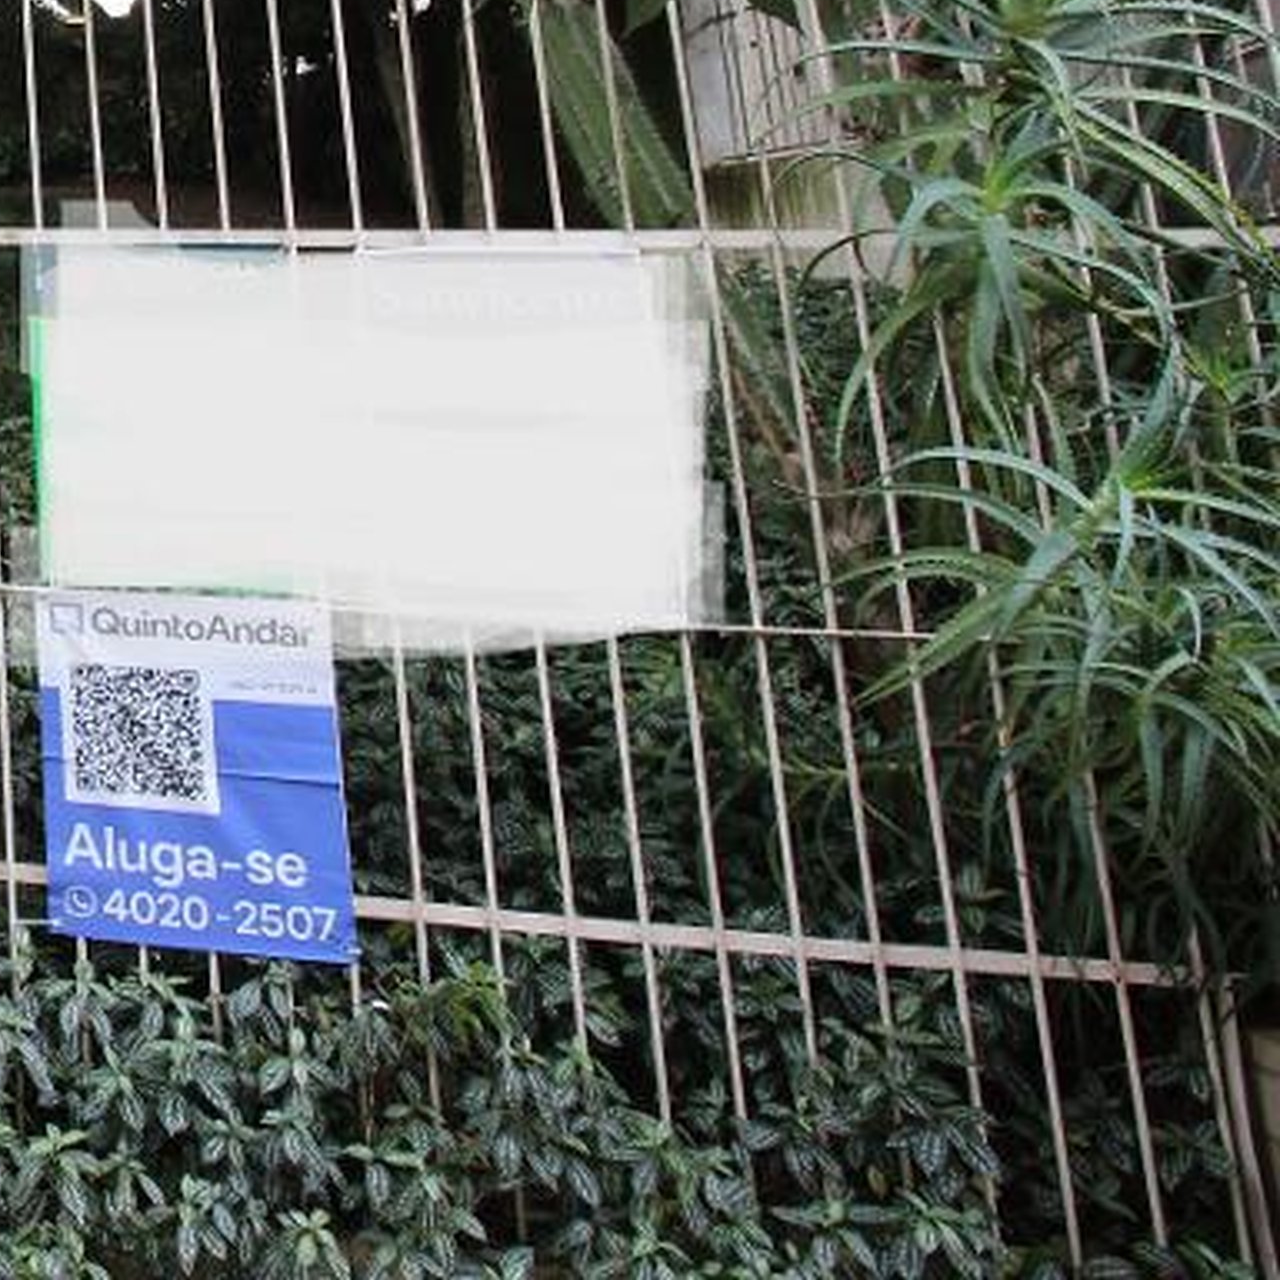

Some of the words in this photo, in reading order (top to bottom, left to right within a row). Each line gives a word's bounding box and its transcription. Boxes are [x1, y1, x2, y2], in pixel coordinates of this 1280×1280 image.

[92, 607, 312, 648] QuintoAndar
[64, 822, 308, 887] Aluga-se
[103, 890, 337, 942] 4020-2507
